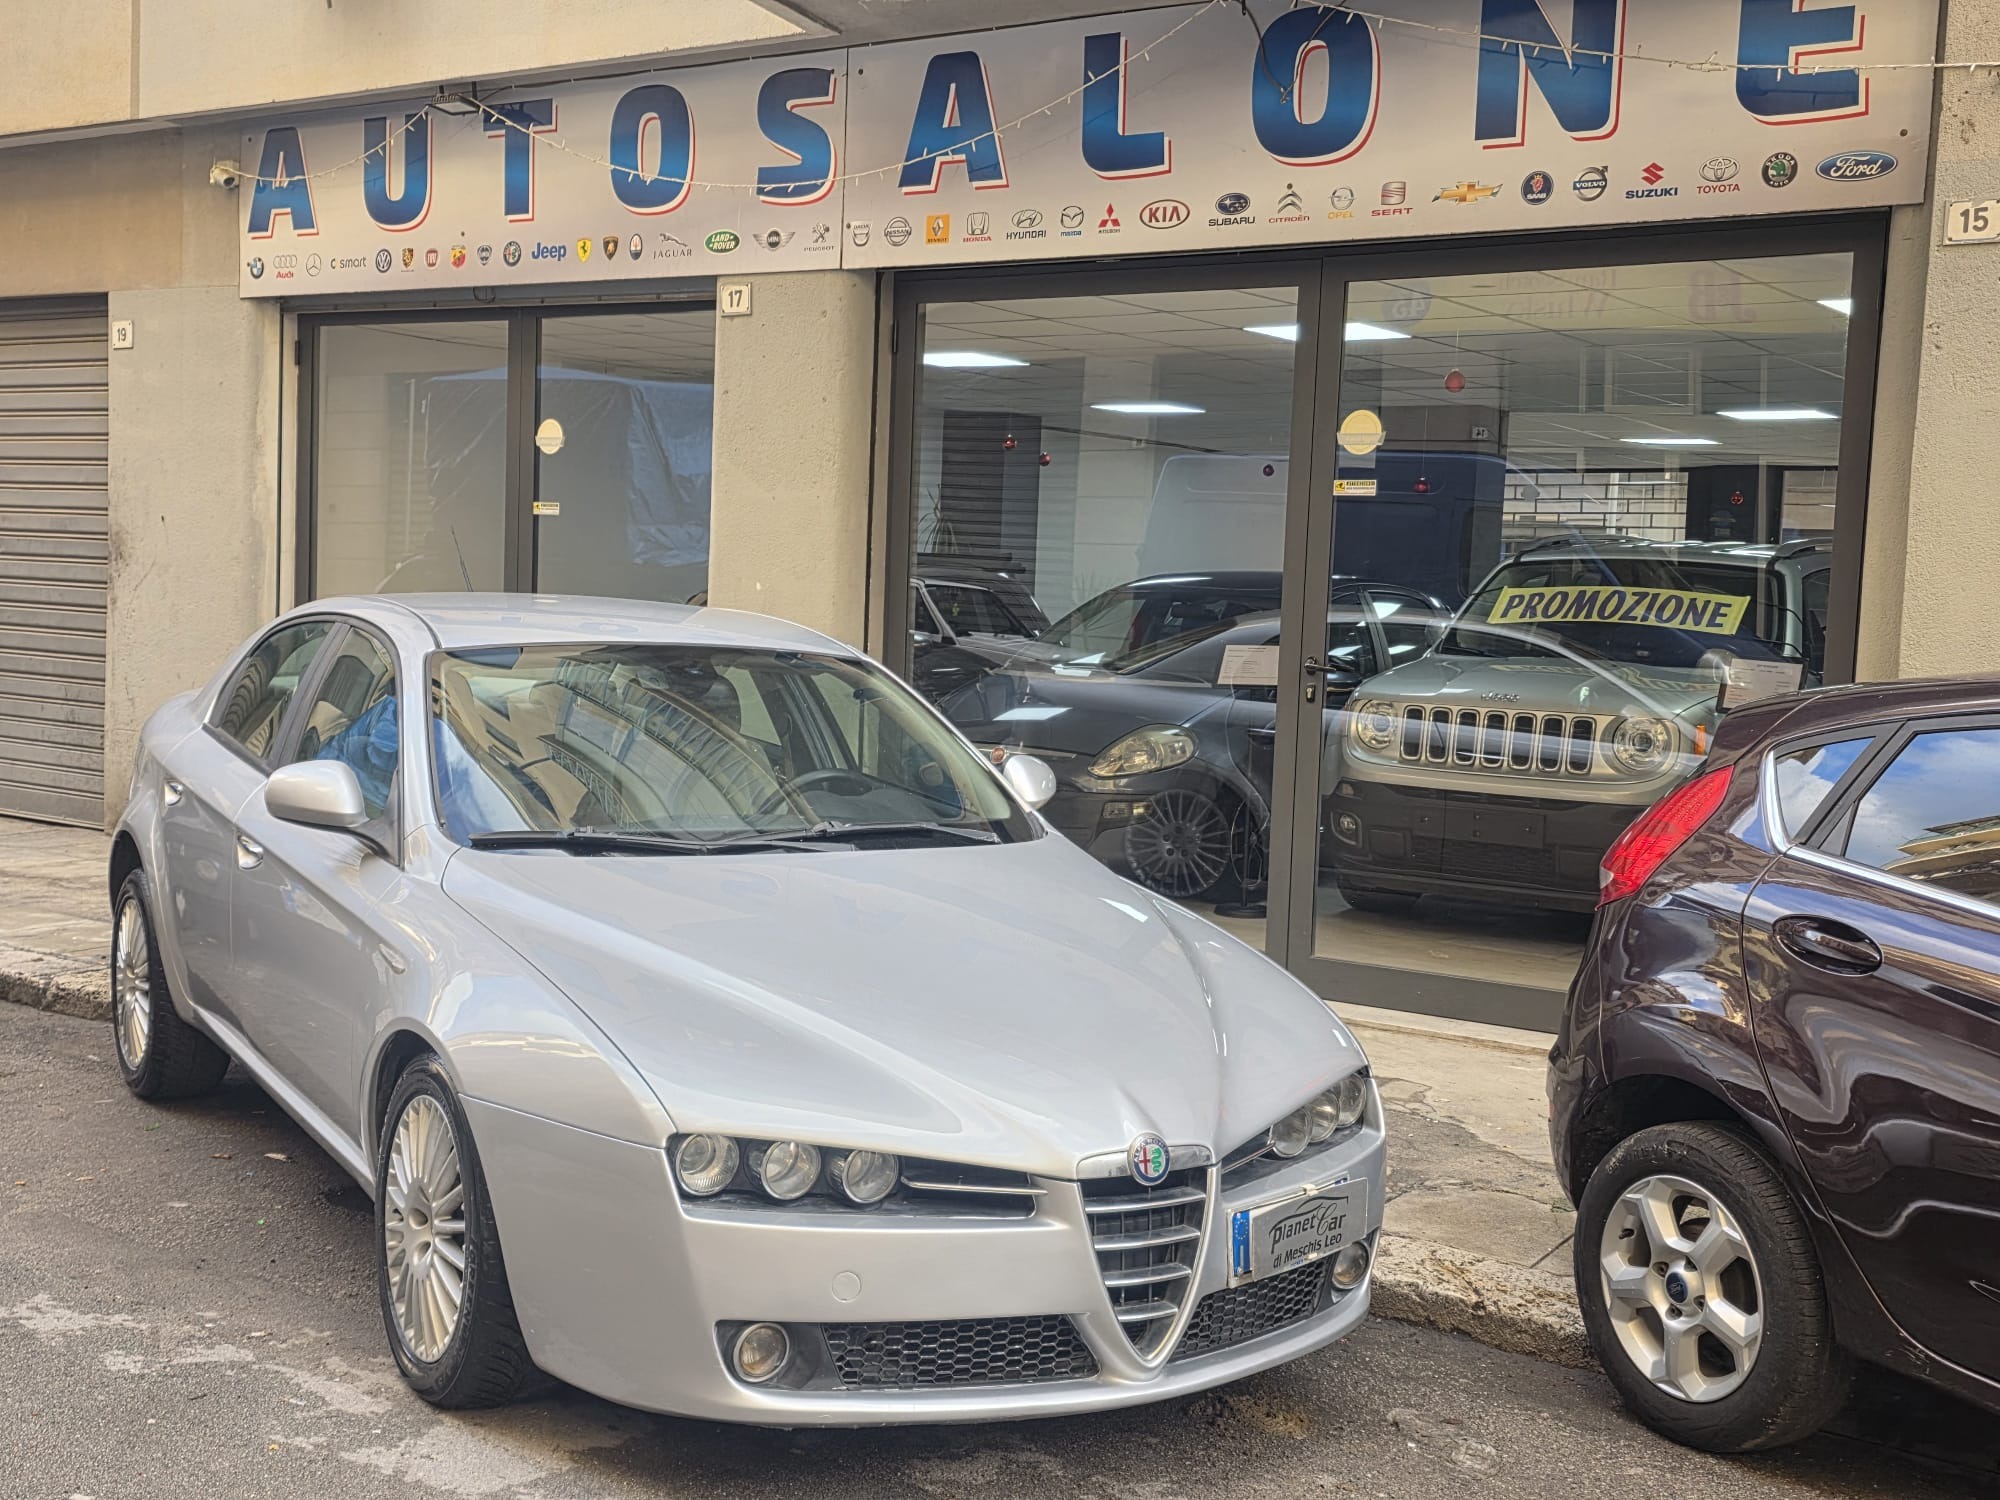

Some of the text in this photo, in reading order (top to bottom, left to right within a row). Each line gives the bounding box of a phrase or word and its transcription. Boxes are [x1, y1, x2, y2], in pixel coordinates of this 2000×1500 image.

[1830, 155, 1884, 177] Ford
[1575, 181, 1605, 189] VOLVO
[1696, 184, 1740, 194] TOYOTA
[1625, 187, 1678, 199] SUZUKI
[1148, 205, 1181, 223] KIA
[1327, 210, 1354, 219] OPEL
[1371, 208, 1413, 217] SEAT
[1208, 216, 1255, 227] SUBARU
[1960, 206, 1989, 233] 15
[711, 233, 730, 242] LAND
[886, 228, 908, 236] NISSAN
[1006, 230, 1047, 240] HYUNDAI
[531, 241, 567, 262] Jeep
[713, 241, 735, 250] ROVER
[653, 248, 692, 260] JAGUAR
[339, 256, 367, 269] smart
[728, 289, 743, 308] 17
[116, 327, 127, 342] 19
[1500, 589, 1733, 627] PROMOZIONE
[1273, 1254, 1282, 1269] di
[1284, 1238, 1322, 1264] Meschis
[1325, 1233, 1342, 1249] Leo
